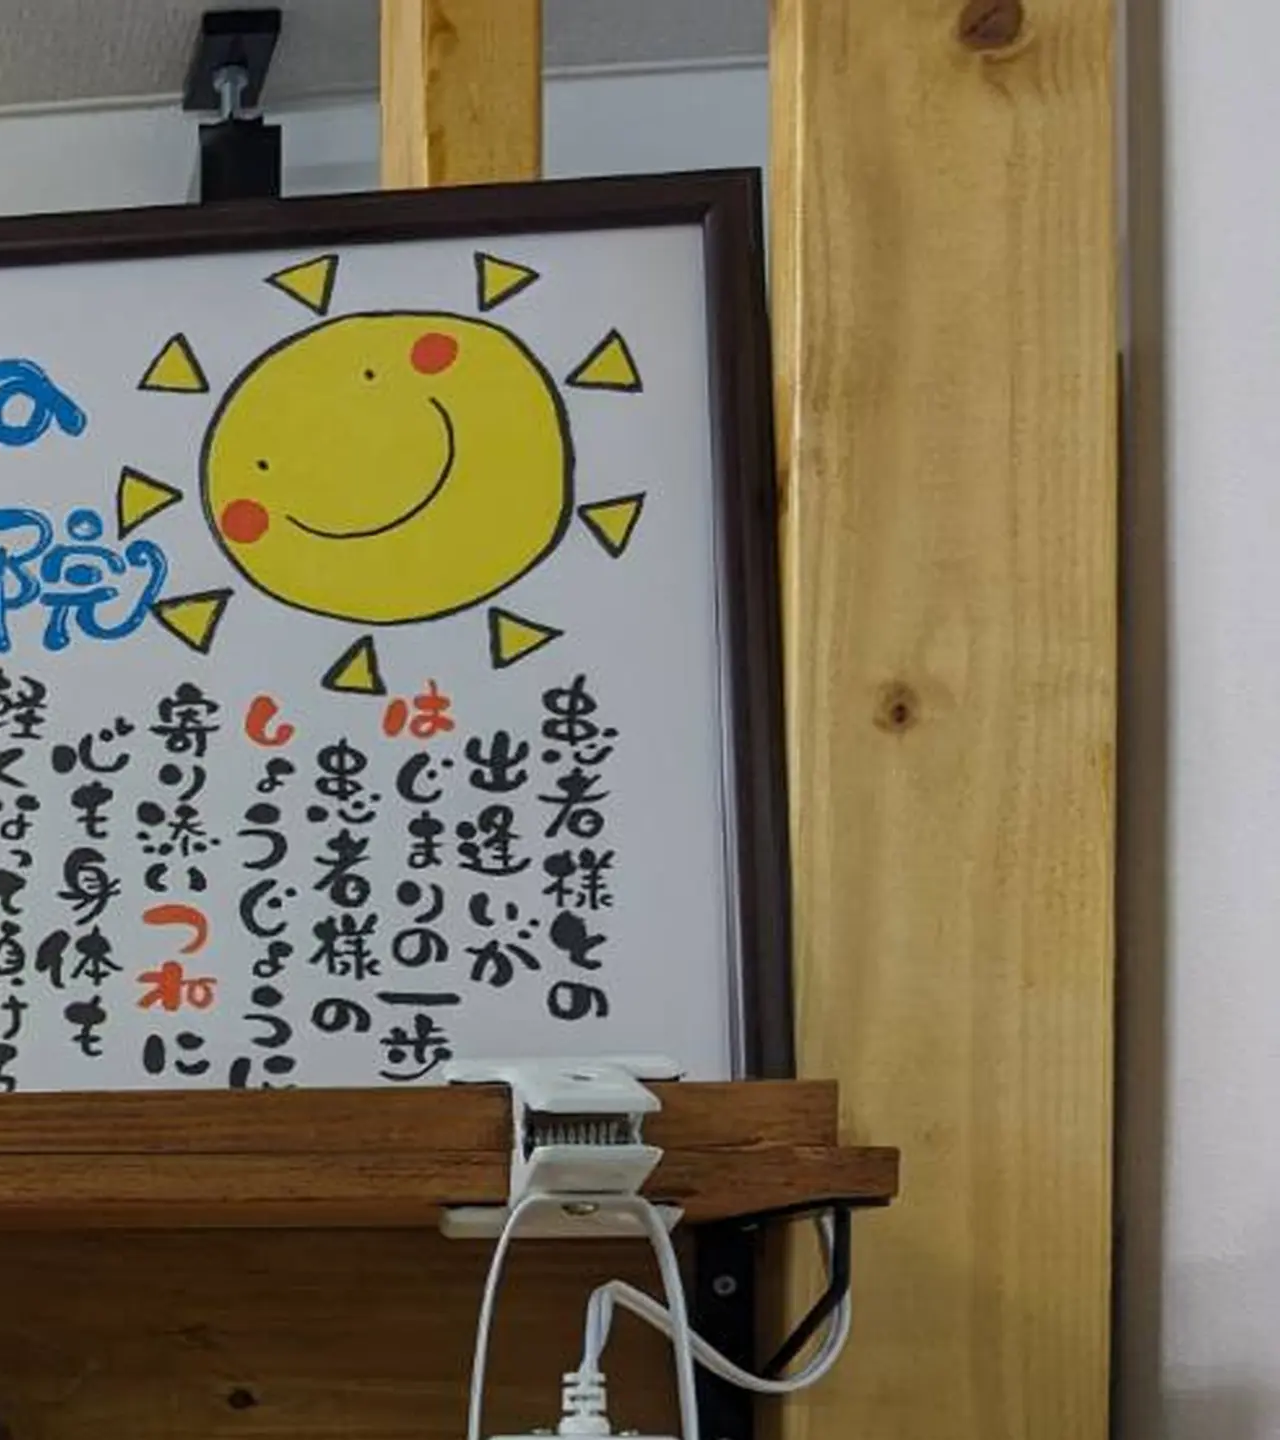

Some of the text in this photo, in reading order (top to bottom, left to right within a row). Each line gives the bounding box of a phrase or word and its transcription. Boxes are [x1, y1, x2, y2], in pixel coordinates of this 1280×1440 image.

[35, 716, 135, 1057] 心も身体も
[135, 681, 221, 1075] 寄り添いつねに
[228, 694, 297, 1090] しょうじょうに
[306, 738, 381, 1034] 患者様の
[376, 679, 463, 1082] はじまりの一歩
[455, 730, 542, 988] 出逢いが
[537, 673, 621, 1020] 患者様との
